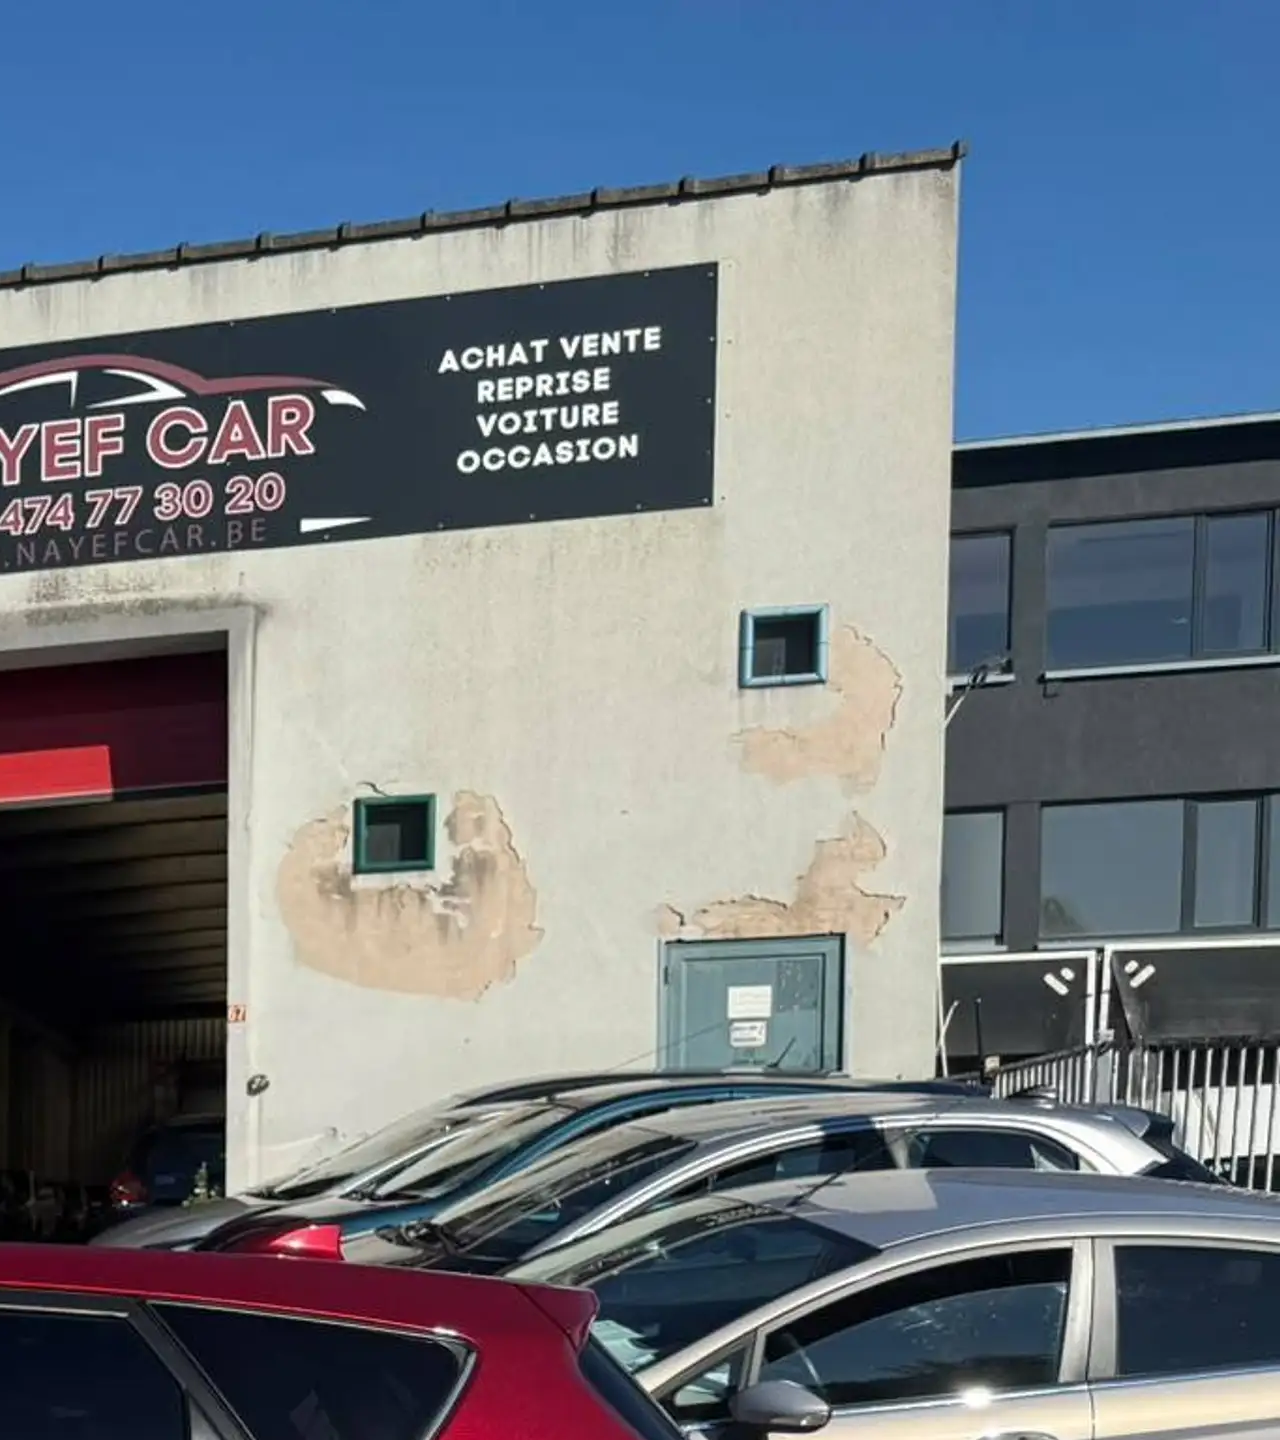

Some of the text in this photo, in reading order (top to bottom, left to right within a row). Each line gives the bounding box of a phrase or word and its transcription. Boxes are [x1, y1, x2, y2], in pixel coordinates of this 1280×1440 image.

[438, 326, 662, 373] ACHAT VENTE
[477, 367, 611, 404] REPRISE
[145, 394, 315, 469] CAR
[476, 401, 619, 437] VOITURE
[457, 434, 638, 474] OCCASION
[85, 486, 142, 528] 77
[154, 479, 214, 521] 30
[225, 472, 286, 516] 20
